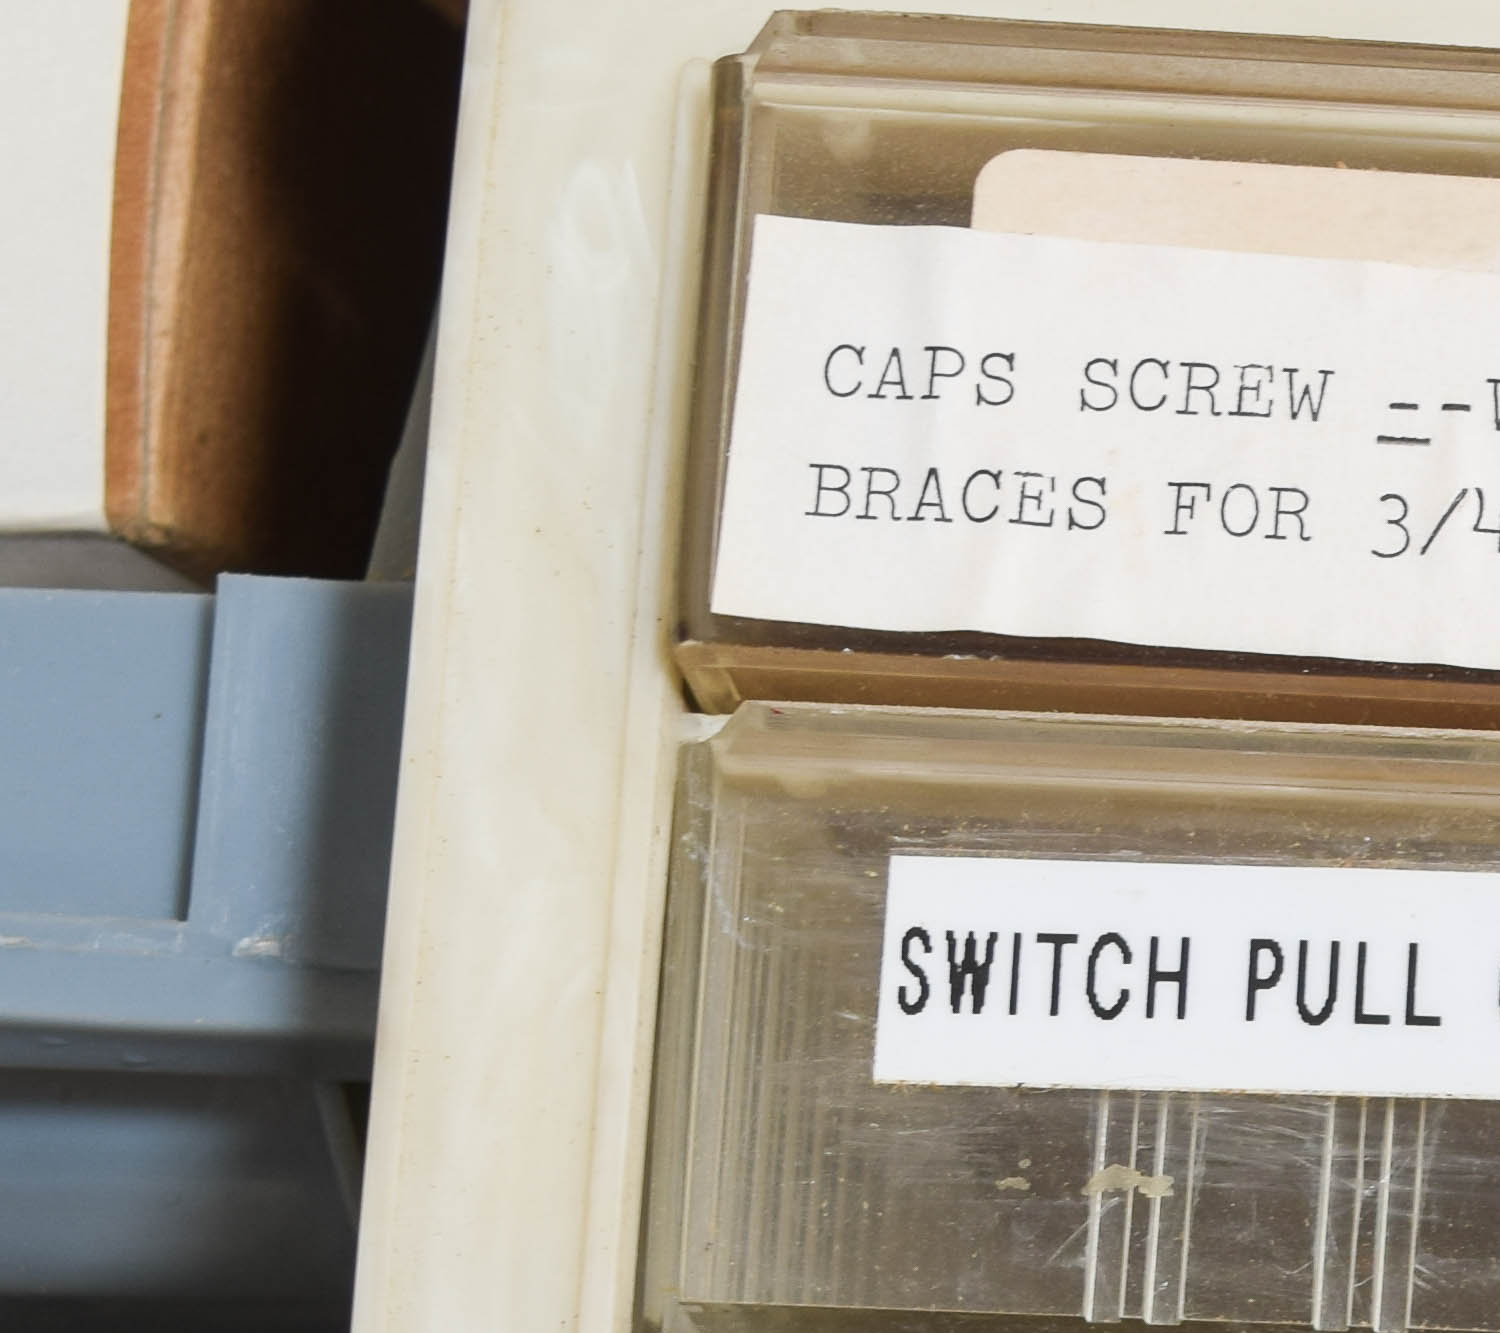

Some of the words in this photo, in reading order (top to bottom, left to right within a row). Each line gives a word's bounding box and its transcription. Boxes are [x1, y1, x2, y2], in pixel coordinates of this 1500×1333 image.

[823, 343, 1016, 407] CAPS
[1079, 357, 1336, 423] SCREW
[804, 463, 1107, 532] BRACES
[1163, 484, 1312, 542] FOR
[896, 925, 1191, 1021] SWITCH
[1245, 937, 1443, 1027] PULL
